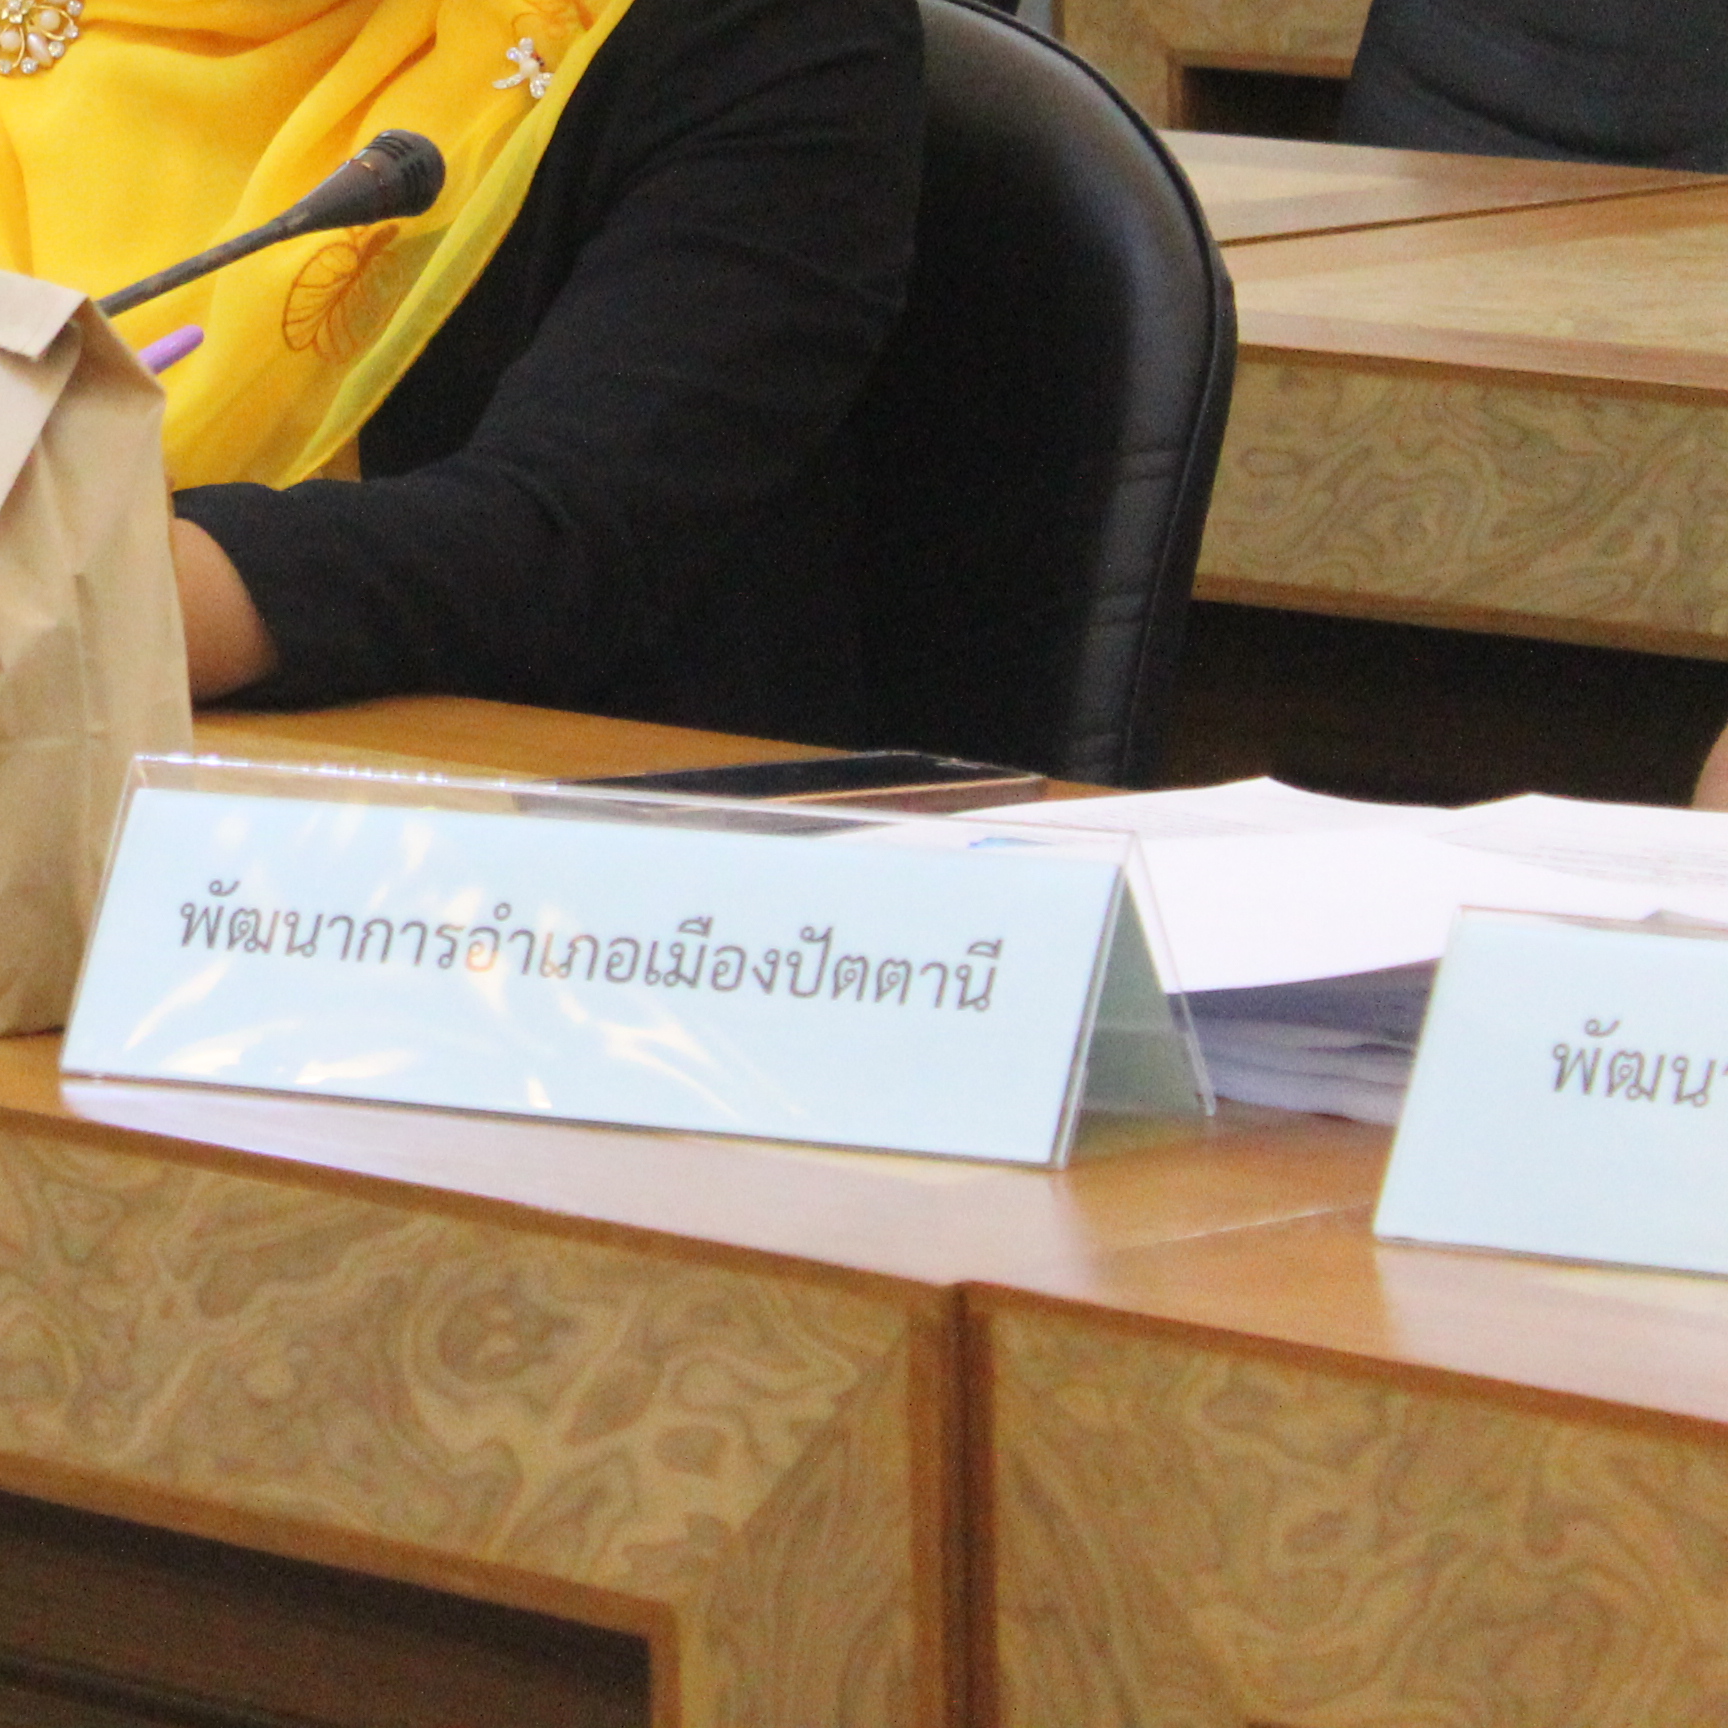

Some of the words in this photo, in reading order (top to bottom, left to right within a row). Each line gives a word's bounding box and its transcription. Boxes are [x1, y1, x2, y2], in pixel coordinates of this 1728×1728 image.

[180, 878, 1004, 1013] พัฒนาการอำเภอเมืองปัตตานี
[1550, 1017, 1728, 1108] พัฒน
